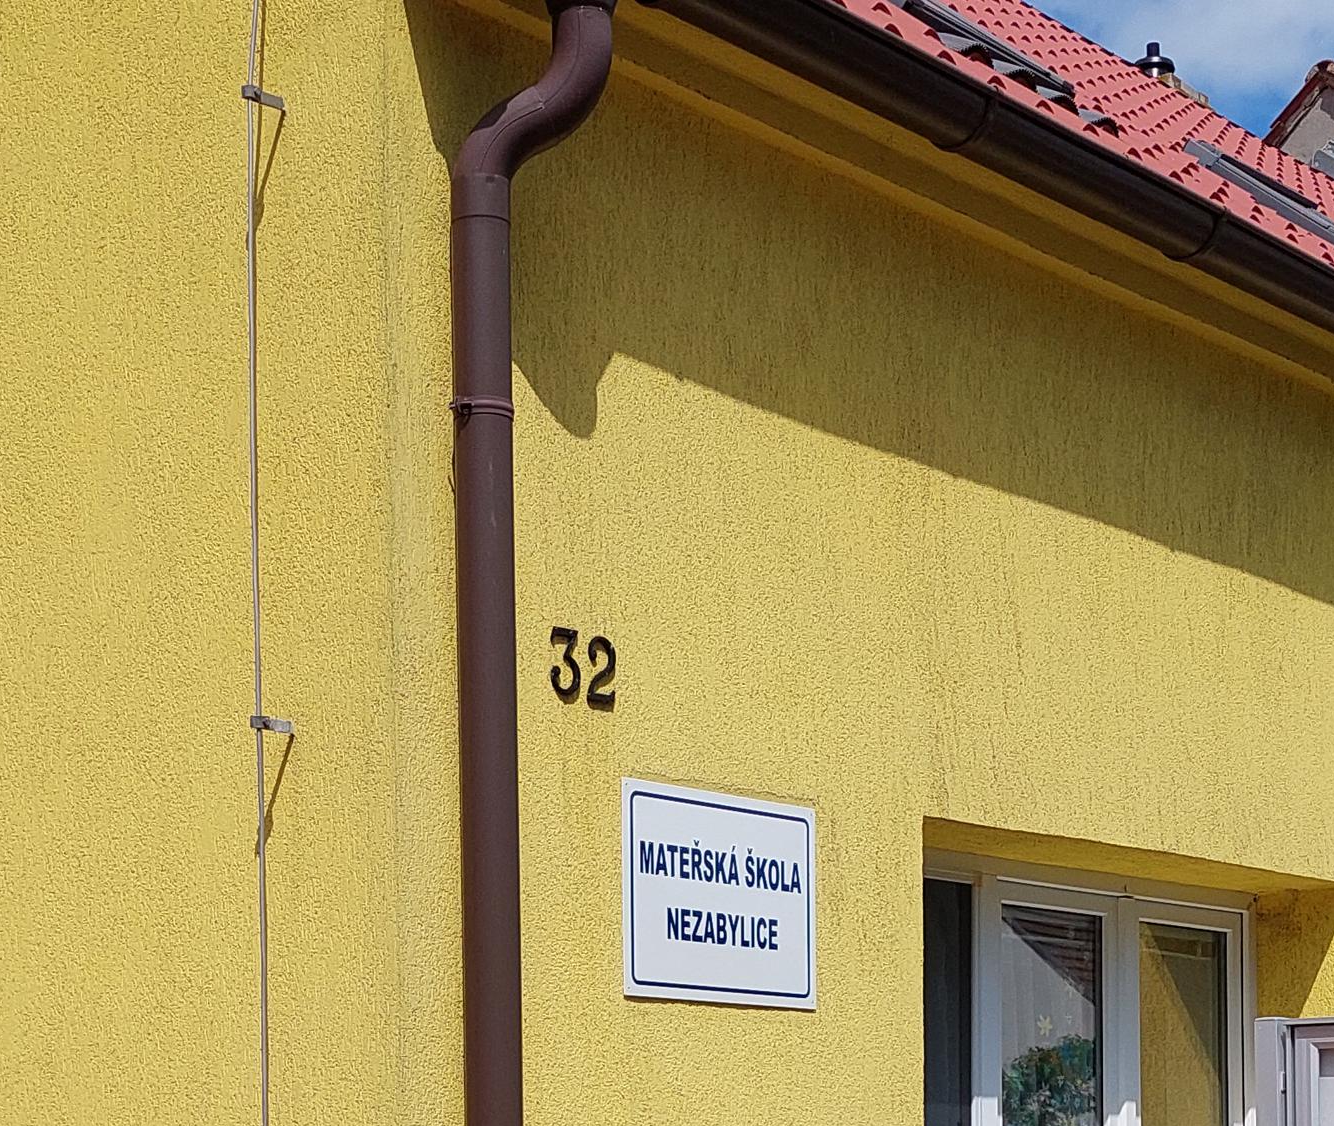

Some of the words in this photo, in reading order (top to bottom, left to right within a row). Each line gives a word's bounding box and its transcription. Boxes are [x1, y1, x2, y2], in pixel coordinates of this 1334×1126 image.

[551, 626, 617, 707] 32
[640, 840, 740, 886] MATEŘSKÁ
[745, 848, 802, 894] ŠKOLA
[667, 907, 779, 950] NEZABYLICE
